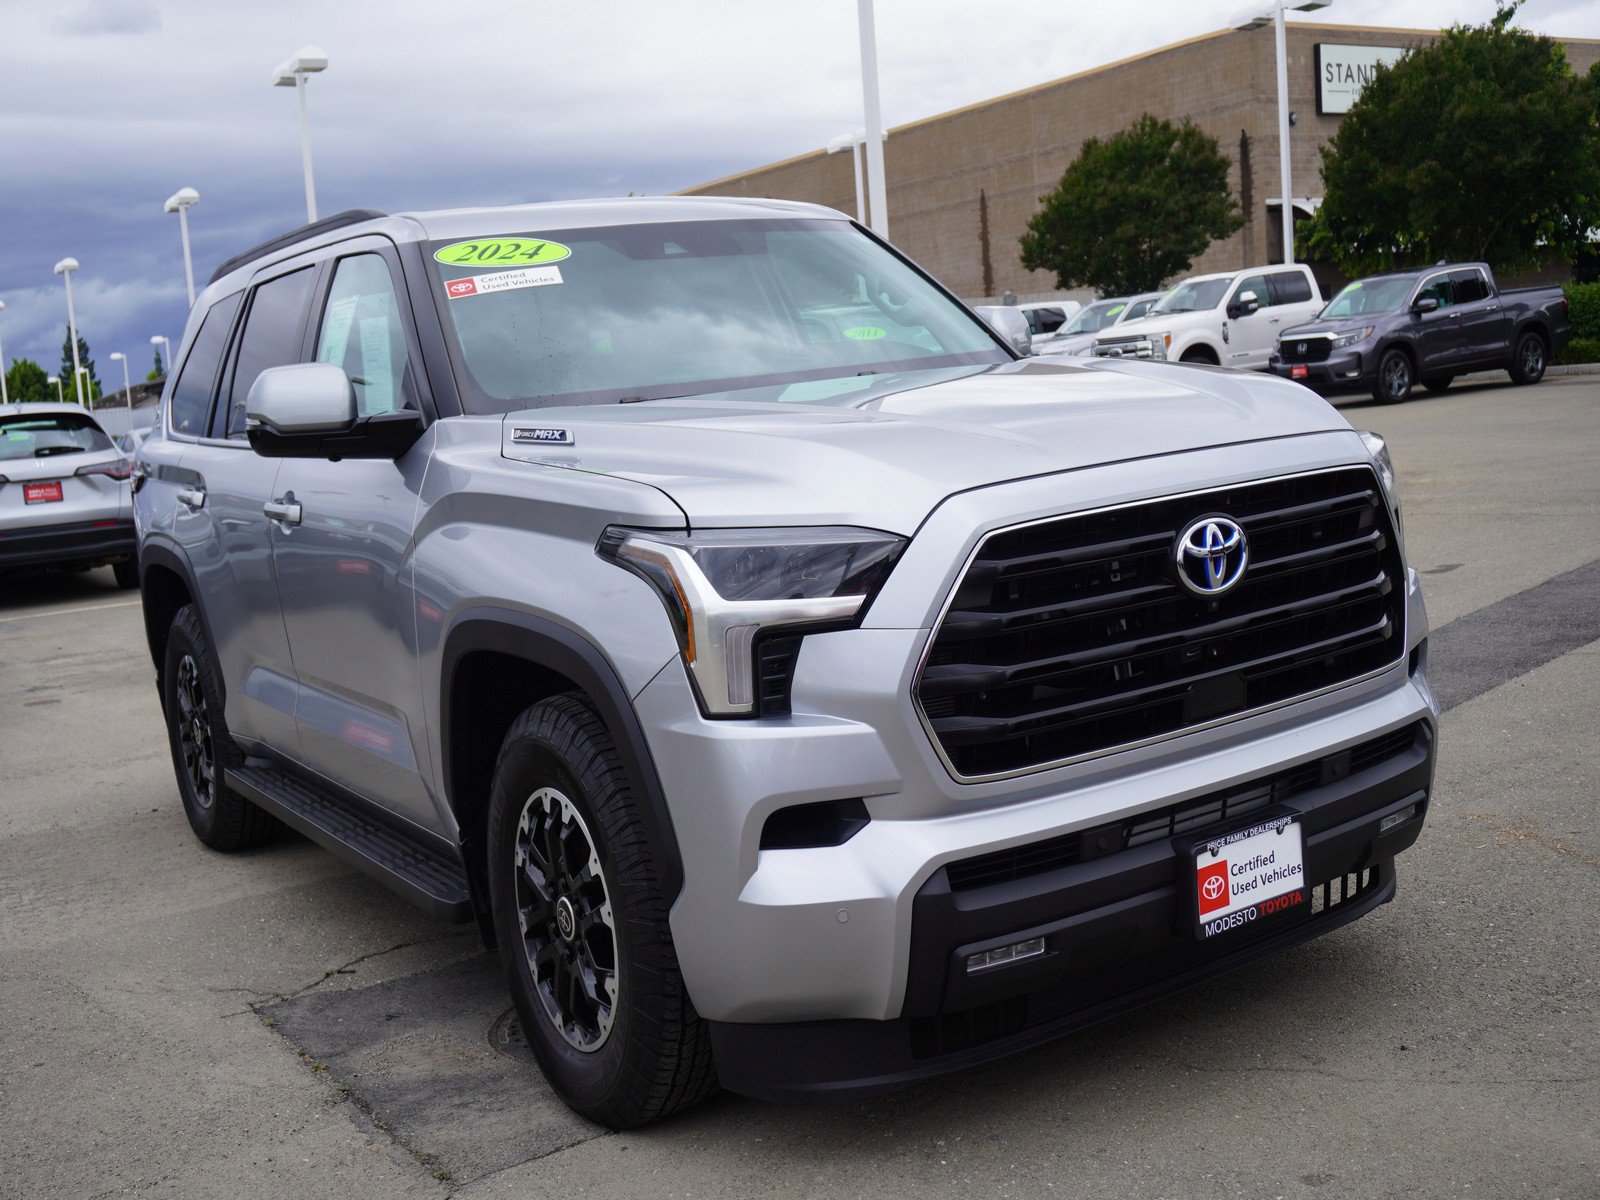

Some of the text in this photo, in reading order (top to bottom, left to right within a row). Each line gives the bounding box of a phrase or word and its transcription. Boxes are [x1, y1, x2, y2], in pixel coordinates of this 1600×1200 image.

[452, 242, 547, 262] 2024
[480, 271, 526, 283] Certified
[482, 275, 555, 291] Used Vehicles
[534, 429, 562, 440] MAX
[1206, 816, 1292, 851] PRICE FAMILY DEALERSHIPS
[1230, 850, 1275, 877] Certified
[1231, 863, 1302, 896] Used Vehicles
[1205, 890, 1303, 938] MODESTO TOYOTA
